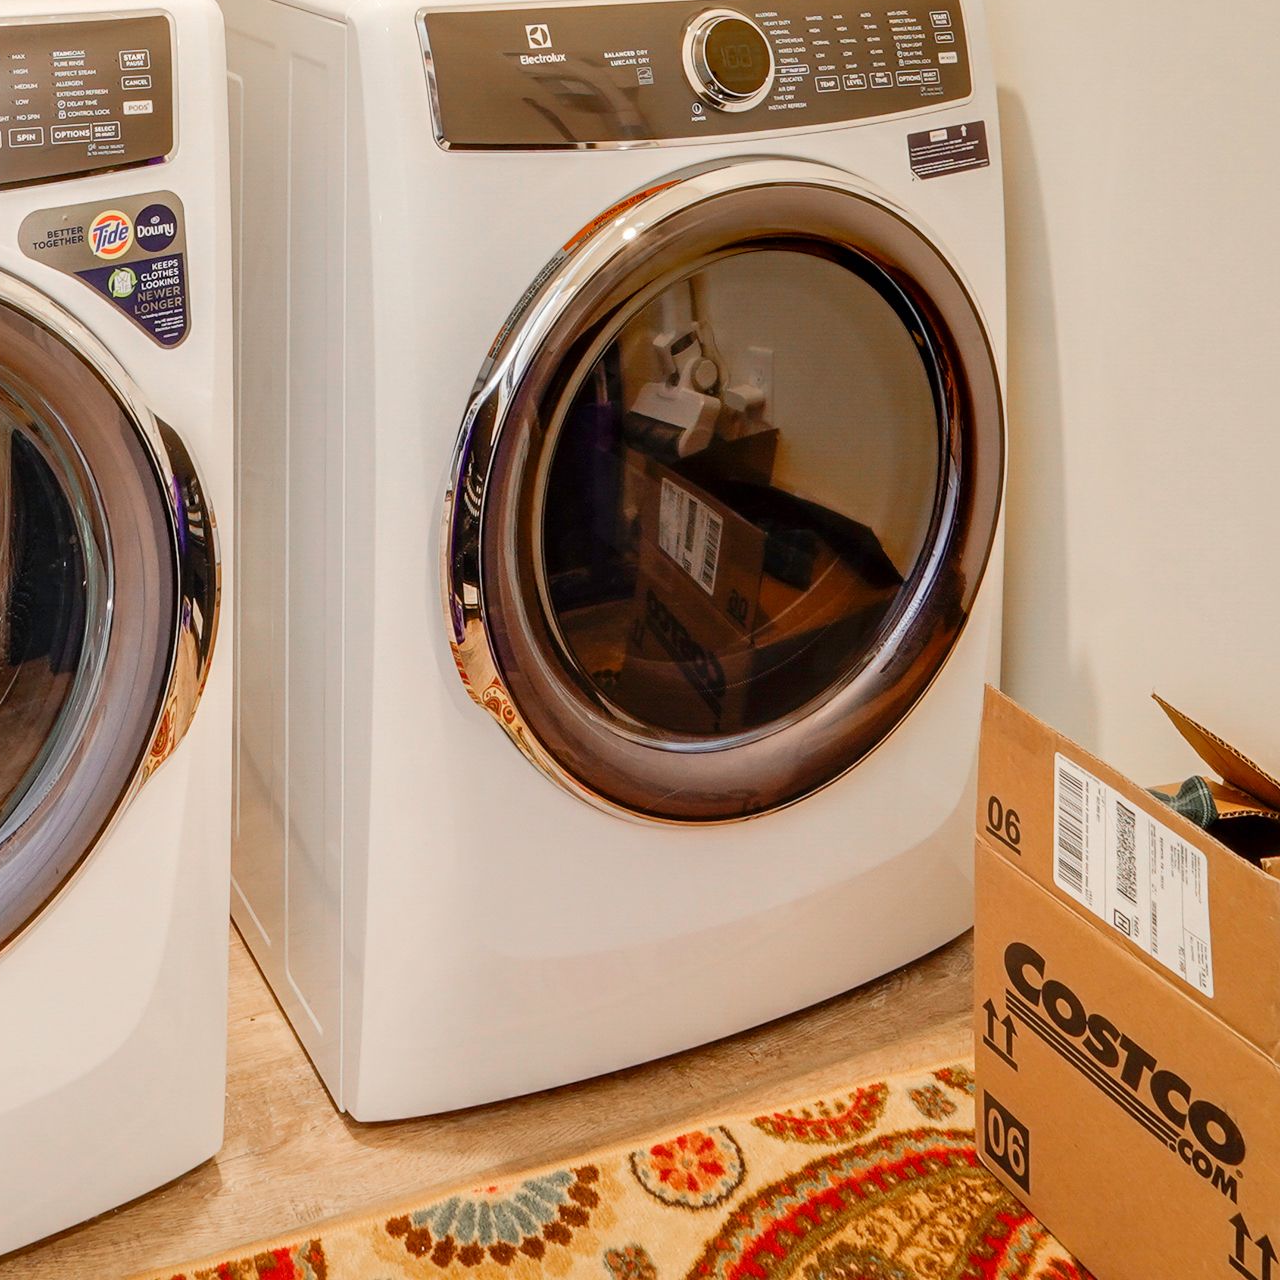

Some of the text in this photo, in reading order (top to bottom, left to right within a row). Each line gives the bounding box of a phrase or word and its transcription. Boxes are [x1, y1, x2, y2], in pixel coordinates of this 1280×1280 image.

[123, 53, 146, 61] START
[520, 53, 567, 65] Electrolux
[604, 50, 636, 59] BALANCED
[610, 59, 637, 67] LUXCARE
[15, 98, 29, 106] LOW
[16, 133, 36, 142] SPIN
[54, 129, 90, 139] OPTIONS
[47, 226, 84, 239] BETTER
[137, 221, 175, 238] Downy
[33, 235, 84, 250] TOGETHER
[93, 222, 129, 254] Tide
[151, 259, 178, 271] KEEPS
[140, 268, 179, 281] CLOTHES
[141, 276, 180, 290] LOOKING
[137, 287, 181, 302] NEWER
[988, 795, 1021, 845] 06
[1004, 942, 1246, 1166] COSTCO
[988, 1108, 1025, 1177] 06
